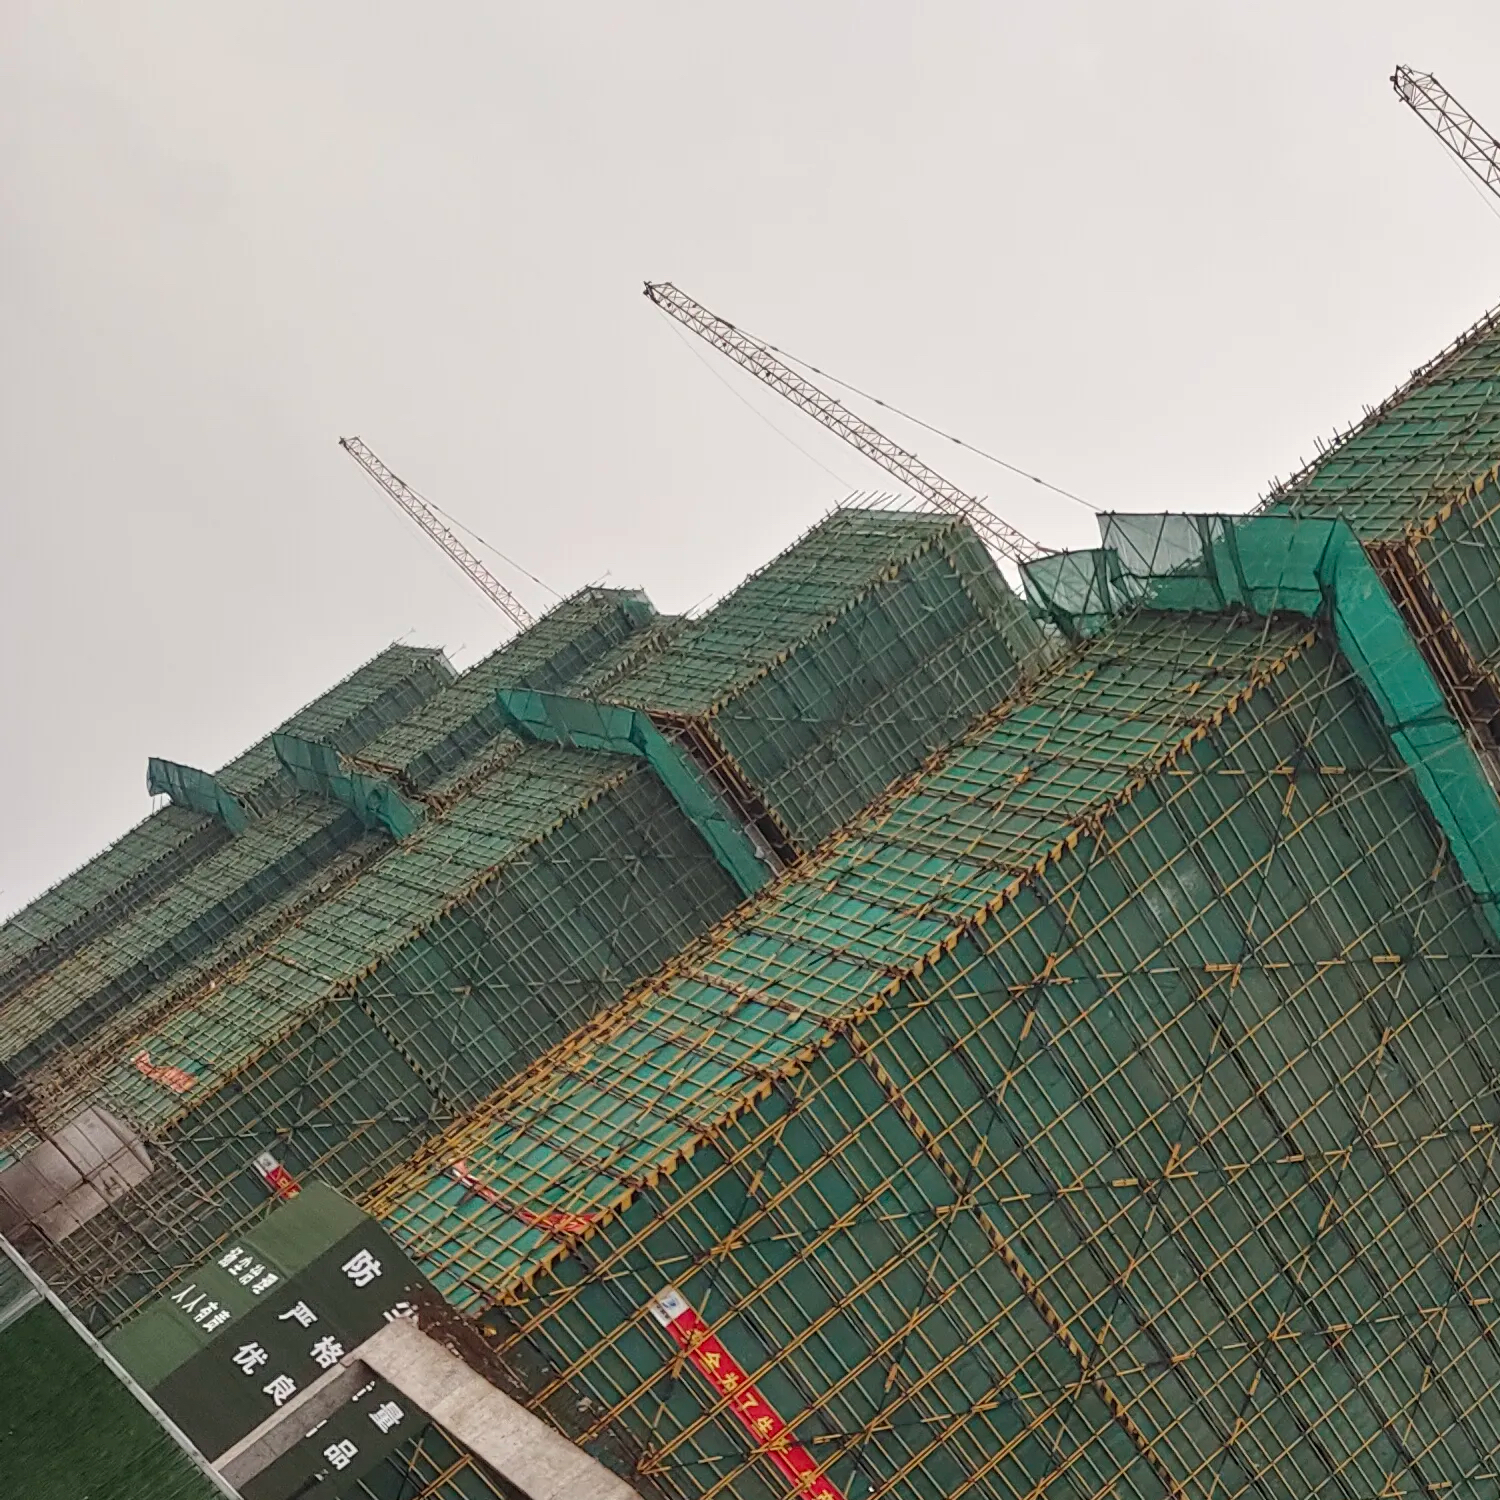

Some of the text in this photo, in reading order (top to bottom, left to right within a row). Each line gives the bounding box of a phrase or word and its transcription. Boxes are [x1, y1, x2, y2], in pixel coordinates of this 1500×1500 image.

[171, 1284, 232, 1333] 人人有责
[217, 1246, 279, 1295] 扬尘治理
[232, 1341, 359, 1471] 优良品
[277, 1300, 405, 1434] 严格量
